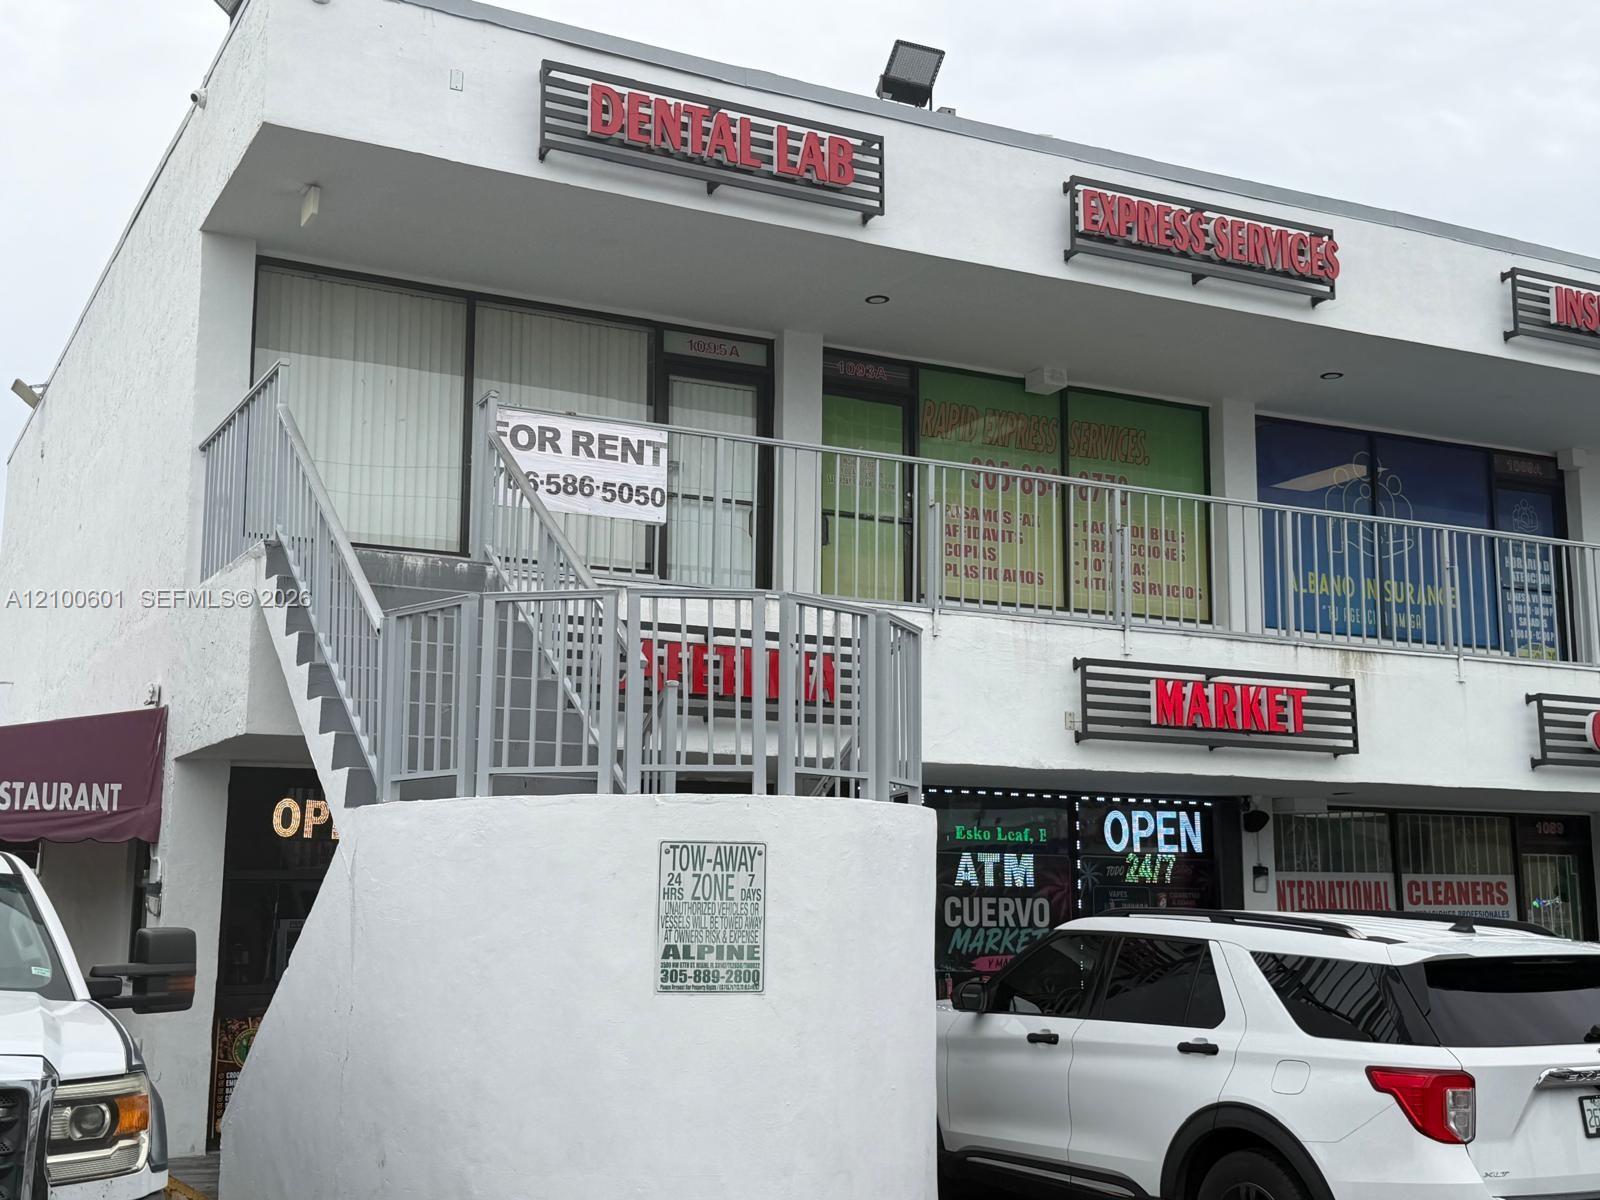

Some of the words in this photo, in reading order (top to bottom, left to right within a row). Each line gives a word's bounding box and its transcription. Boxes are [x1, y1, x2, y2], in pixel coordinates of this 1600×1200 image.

[587, 82, 762, 168] DENTAL
[773, 123, 855, 187] LAB
[1078, 187, 1206, 254] EXPRESS
[1209, 216, 1340, 280] SERVICES
[1550, 285, 1600, 333] INS
[688, 340, 740, 357] 1095A
[921, 400, 980, 442] RAPID
[981, 407, 1058, 454] EXPRESS
[496, 420, 562, 454] FOR
[571, 429, 667, 467] RENT
[1150, 679, 1308, 733] MARKET
[0, 781, 123, 811] STAURANT
[272, 798, 340, 838] OP
[1104, 810, 1203, 853] OPEN
[955, 825, 991, 840] Esko
[669, 844, 758, 872] TOW-AWAY
[954, 852, 1035, 887] ATM
[1125, 852, 1176, 883] 24/7
[667, 872, 682, 886] 24
[690, 873, 735, 901] ZONE
[748, 874, 756, 887] 7
[662, 888, 684, 900] HRS
[740, 888, 762, 901] DAYS
[1276, 879, 1392, 913] NTERNATIONAL
[1406, 879, 1509, 906] CLEANERS
[660, 915, 691, 929] VESSELS
[692, 915, 708, 929] WILL
[709, 916, 719, 929] BE
[720, 916, 743, 929] TOWED
[744, 916, 762, 929] AWAY
[665, 902, 716, 915] UNAUTHORIZED
[717, 902, 749, 915] VEHICLES
[750, 902, 760, 915] OR
[944, 896, 1050, 928] CUERVO
[663, 929, 673, 942] AT
[706, 929, 721, 943] RISK
[722, 930, 728, 943] &
[729, 930, 759, 943] EXPENSE
[948, 927, 1050, 955] MARKET
[661, 944, 760, 960] ALPINE
[660, 969, 760, 984] 305-889-2800
